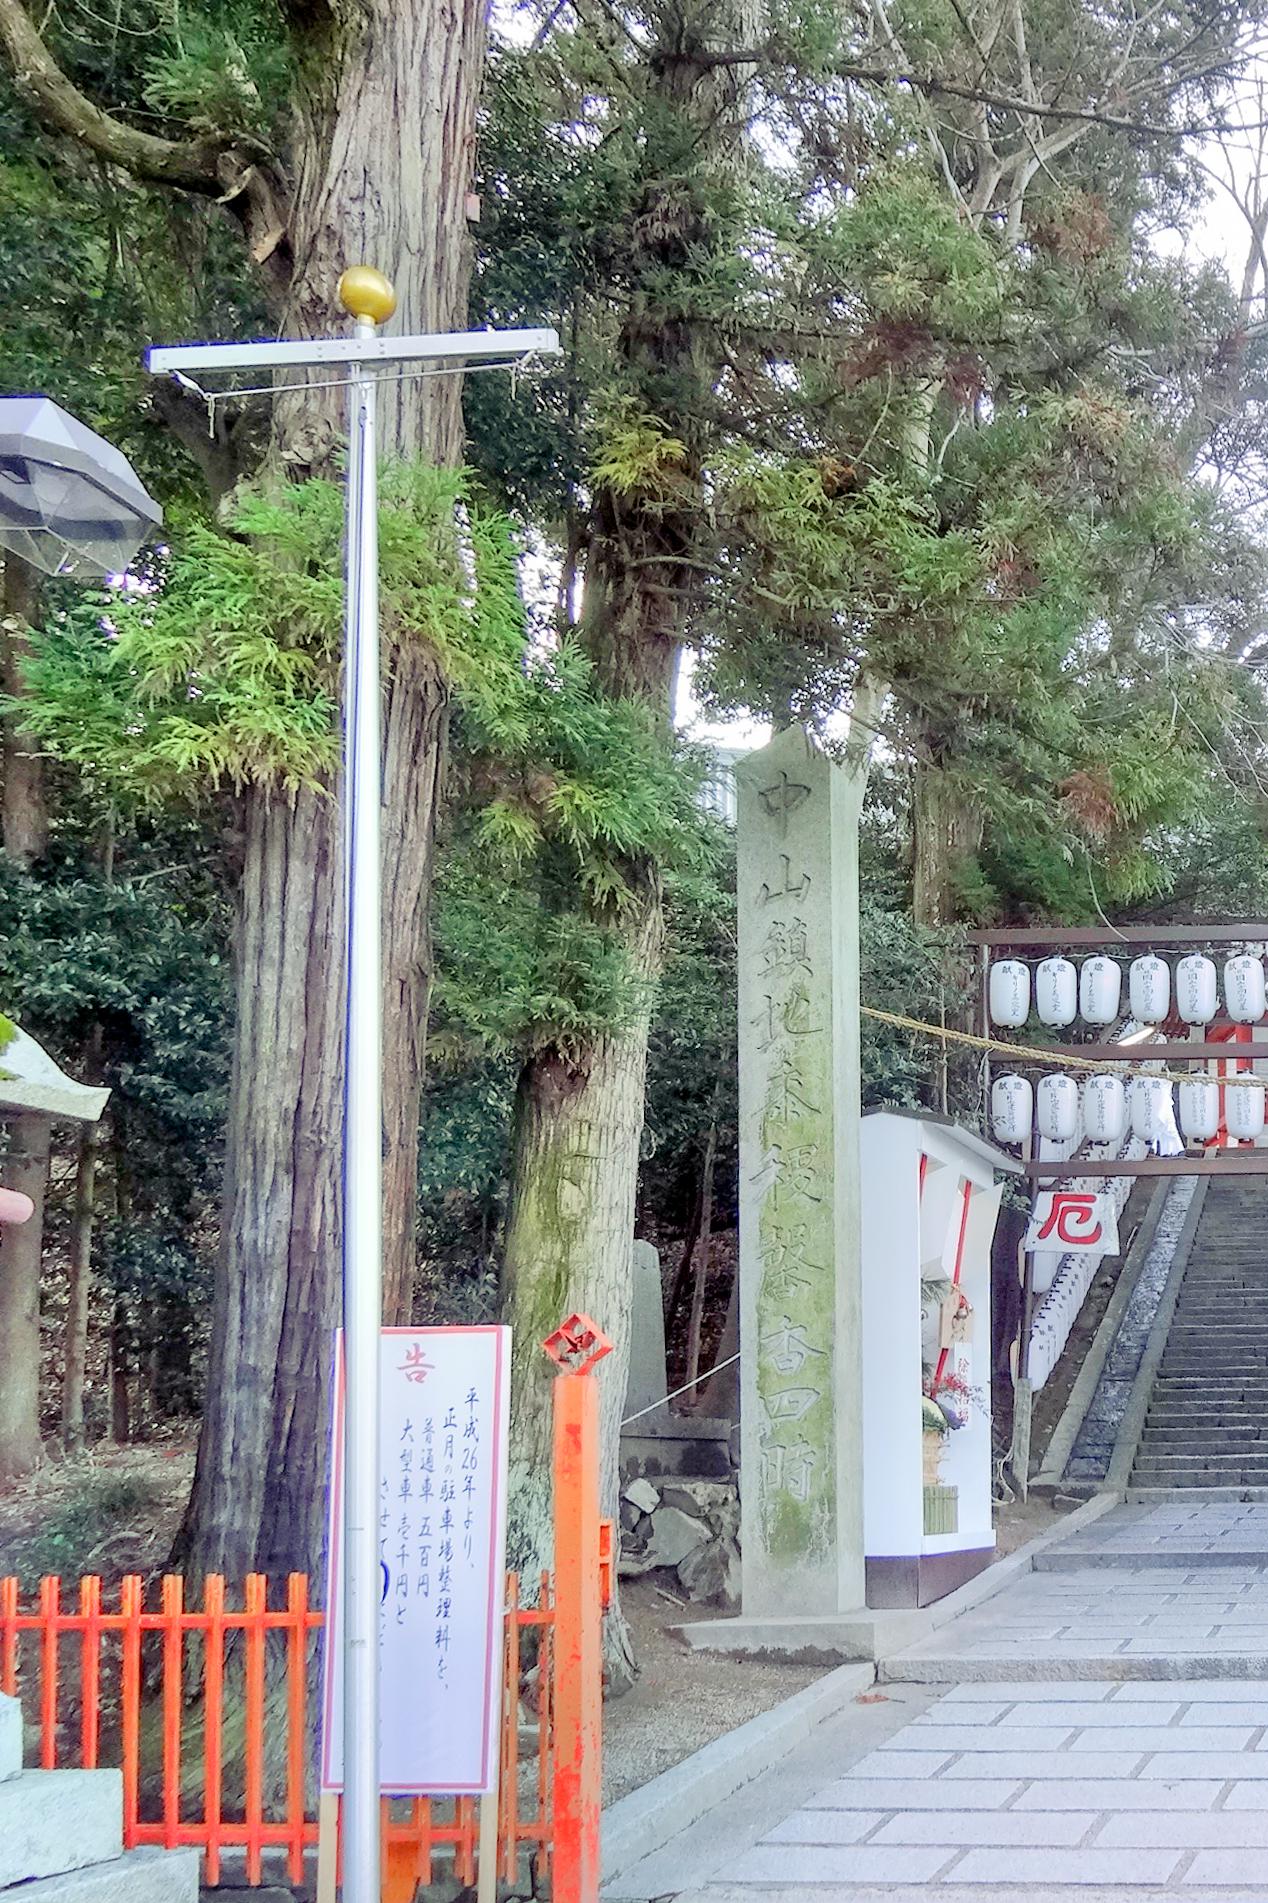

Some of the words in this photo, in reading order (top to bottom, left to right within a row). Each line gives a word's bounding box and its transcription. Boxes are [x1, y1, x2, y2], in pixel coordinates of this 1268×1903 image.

[1037, 1193, 1103, 1245] 厄
[396, 1342, 436, 1384] 告
[397, 1418, 415, 1504] 大型車
[418, 1417, 436, 1504] 普通車
[416, 1516, 433, 1598] 五百円
